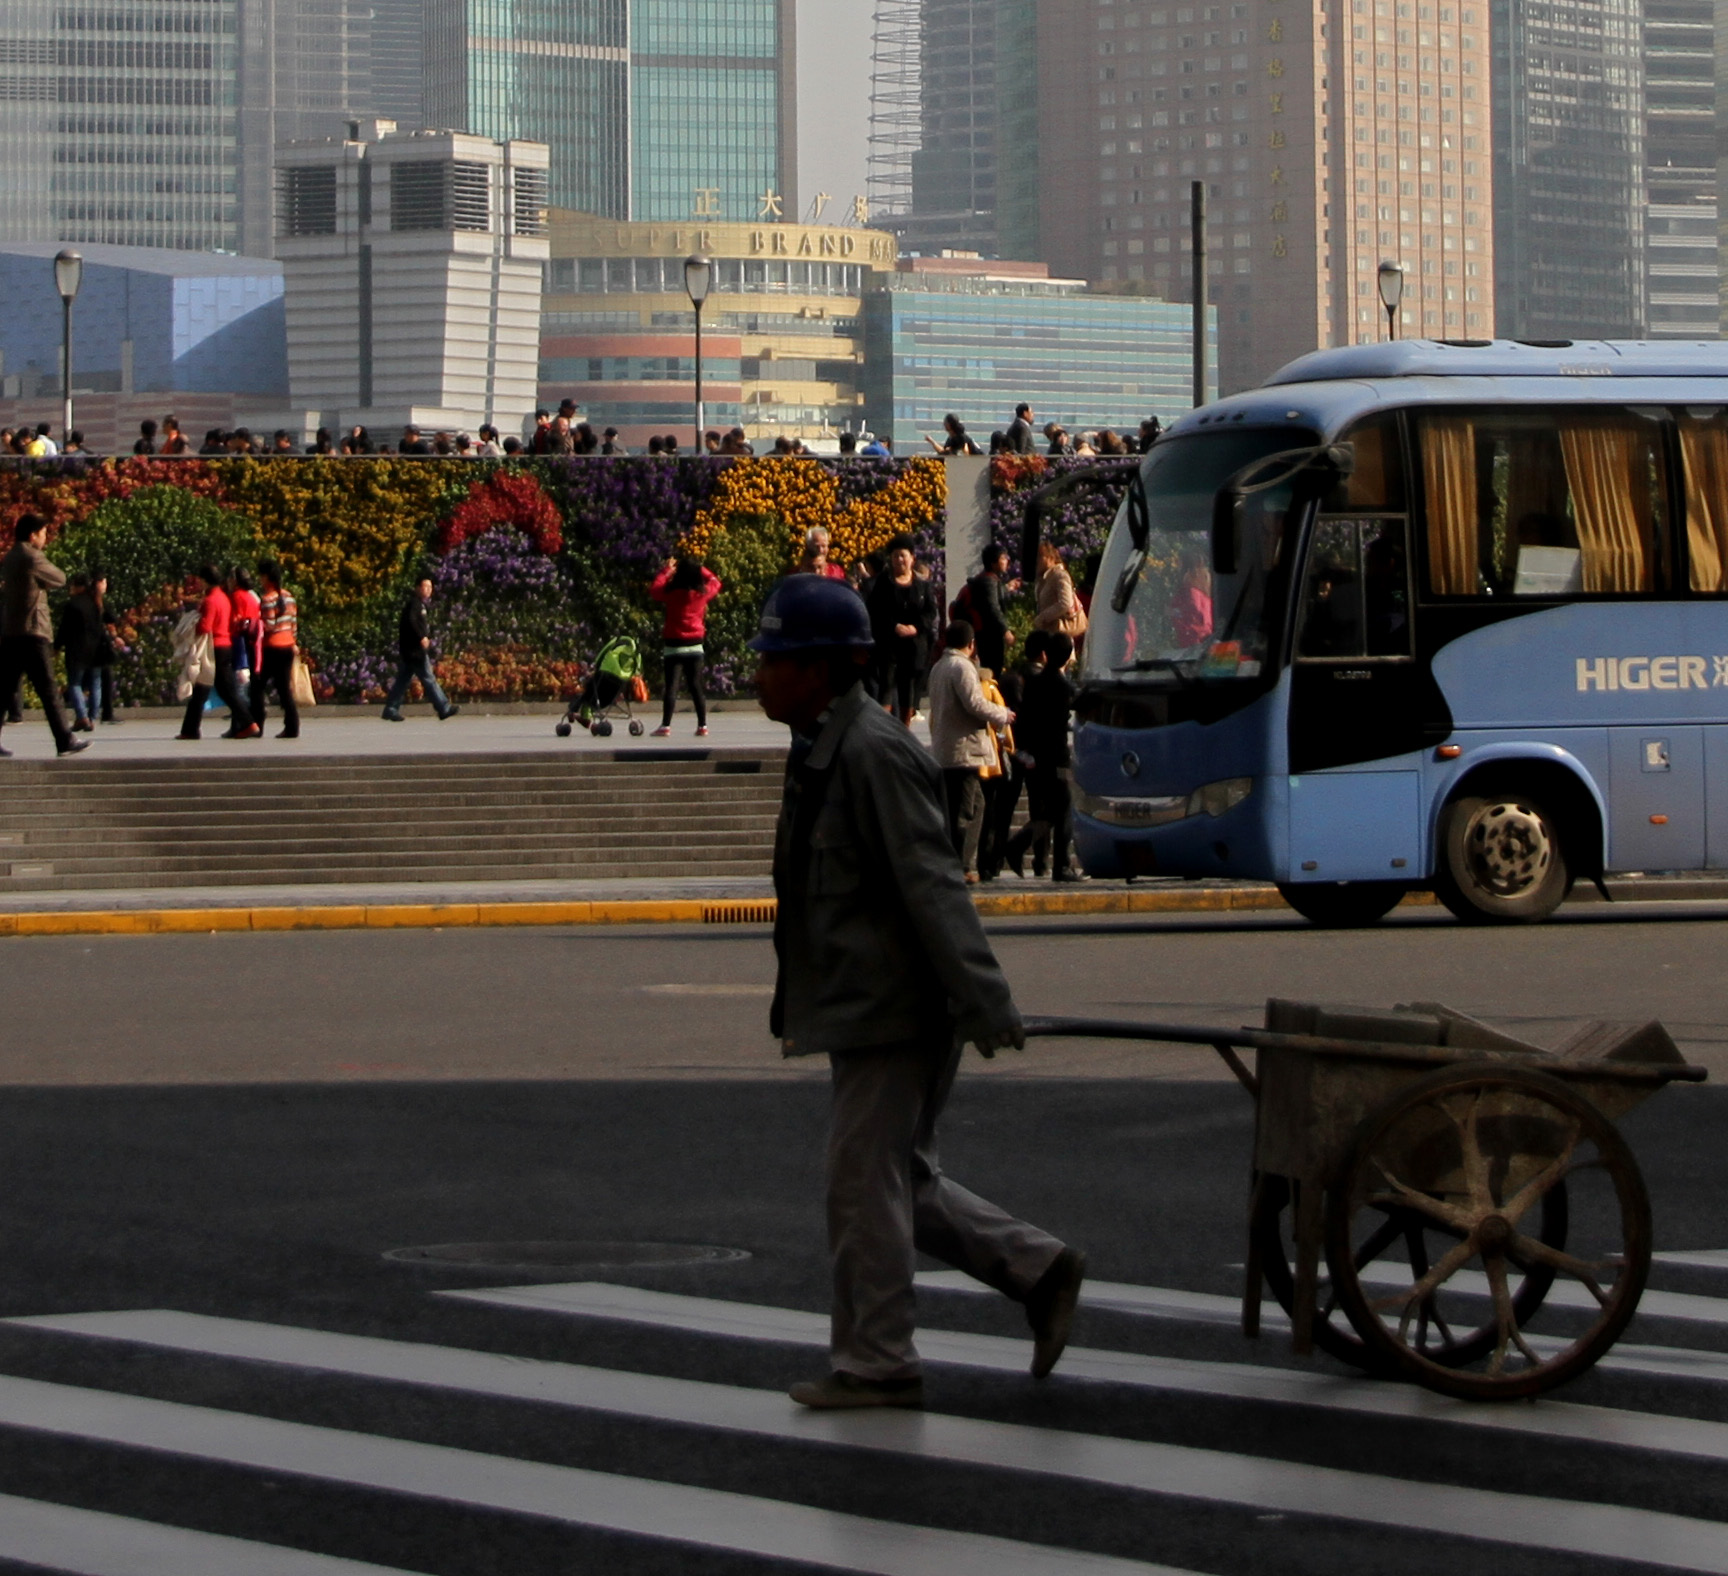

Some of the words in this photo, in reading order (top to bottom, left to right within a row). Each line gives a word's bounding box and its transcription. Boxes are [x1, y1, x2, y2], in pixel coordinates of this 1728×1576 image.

[592, 228, 716, 250] SUPER
[751, 230, 856, 256] BRAND
[1576, 655, 1709, 691] HIGER
